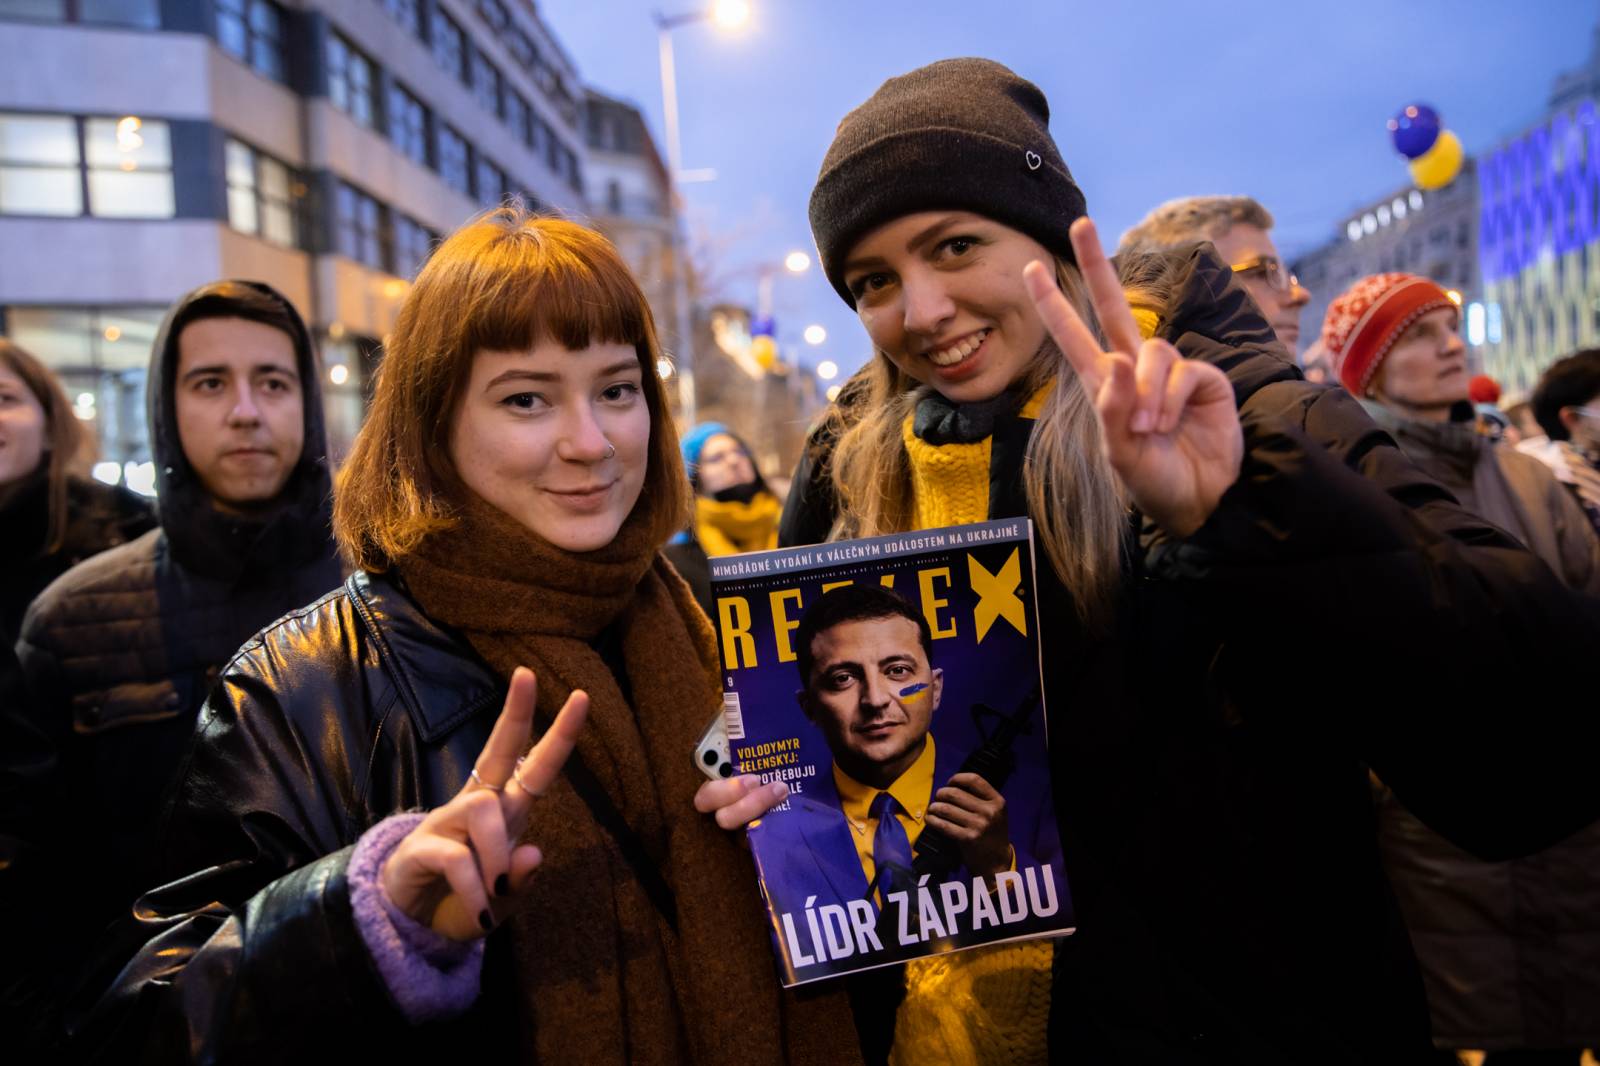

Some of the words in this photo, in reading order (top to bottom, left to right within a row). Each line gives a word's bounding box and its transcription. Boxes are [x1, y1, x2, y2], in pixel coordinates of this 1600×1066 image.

[713, 560, 771, 577] MIMOŘÁDNÉ
[774, 553, 813, 569] VYDÁNÍ
[816, 552, 824, 563] K
[827, 544, 880, 562] VÁLEČNÝM
[884, 535, 945, 554] UDÁLOSTEM
[950, 533, 963, 545] NA
[967, 524, 1019, 543] UKRAJINĚ
[717, 546, 1028, 670] REEX
[727, 676, 734, 687] 9
[737, 738, 800, 760] VOLODYMYR
[782, 895, 884, 968] LÍDR
[887, 863, 1059, 946] ZÁPADU
